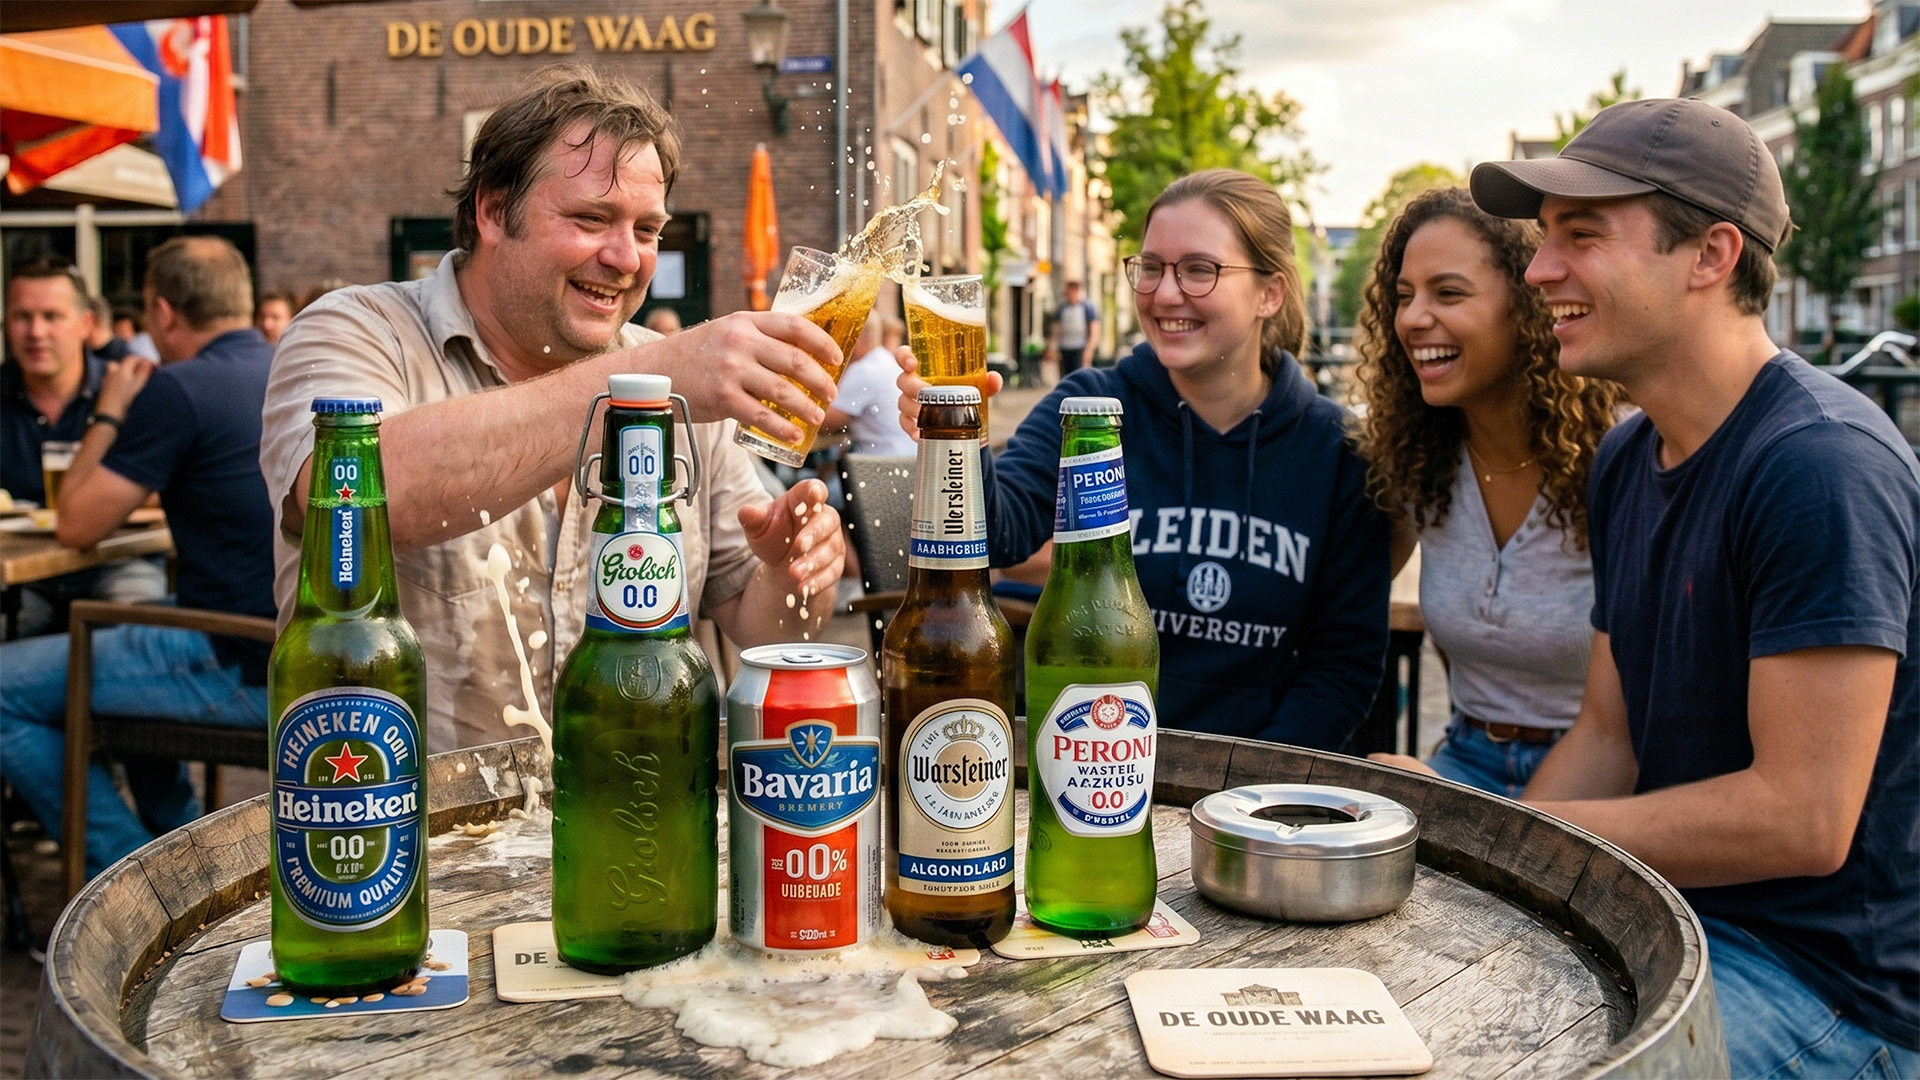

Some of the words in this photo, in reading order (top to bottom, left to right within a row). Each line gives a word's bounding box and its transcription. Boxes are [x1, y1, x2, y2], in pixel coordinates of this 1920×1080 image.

[387, 20, 445, 59] DE
[453, 16, 578, 56] OUDE
[584, 12, 717, 52] WAAG
[1128, 506, 1311, 584] LEIDEN
[601, 552, 677, 587] Grolsch
[622, 583, 658, 609] 0.0
[1150, 608, 1288, 648] IVERSITY
[282, 710, 382, 770] HEINEKEN
[1052, 733, 1153, 764] PERONI
[741, 758, 873, 800] Bavaria
[912, 754, 1008, 787] Warsteiner
[277, 789, 418, 824] Heineken
[1091, 790, 1125, 810] 0.0
[359, 847, 410, 906] QUALITY
[514, 951, 549, 966] DE
[1158, 1011, 1200, 1027] DE
[1207, 1010, 1292, 1027] OUDE
[1294, 1009, 1386, 1026] WAAG
